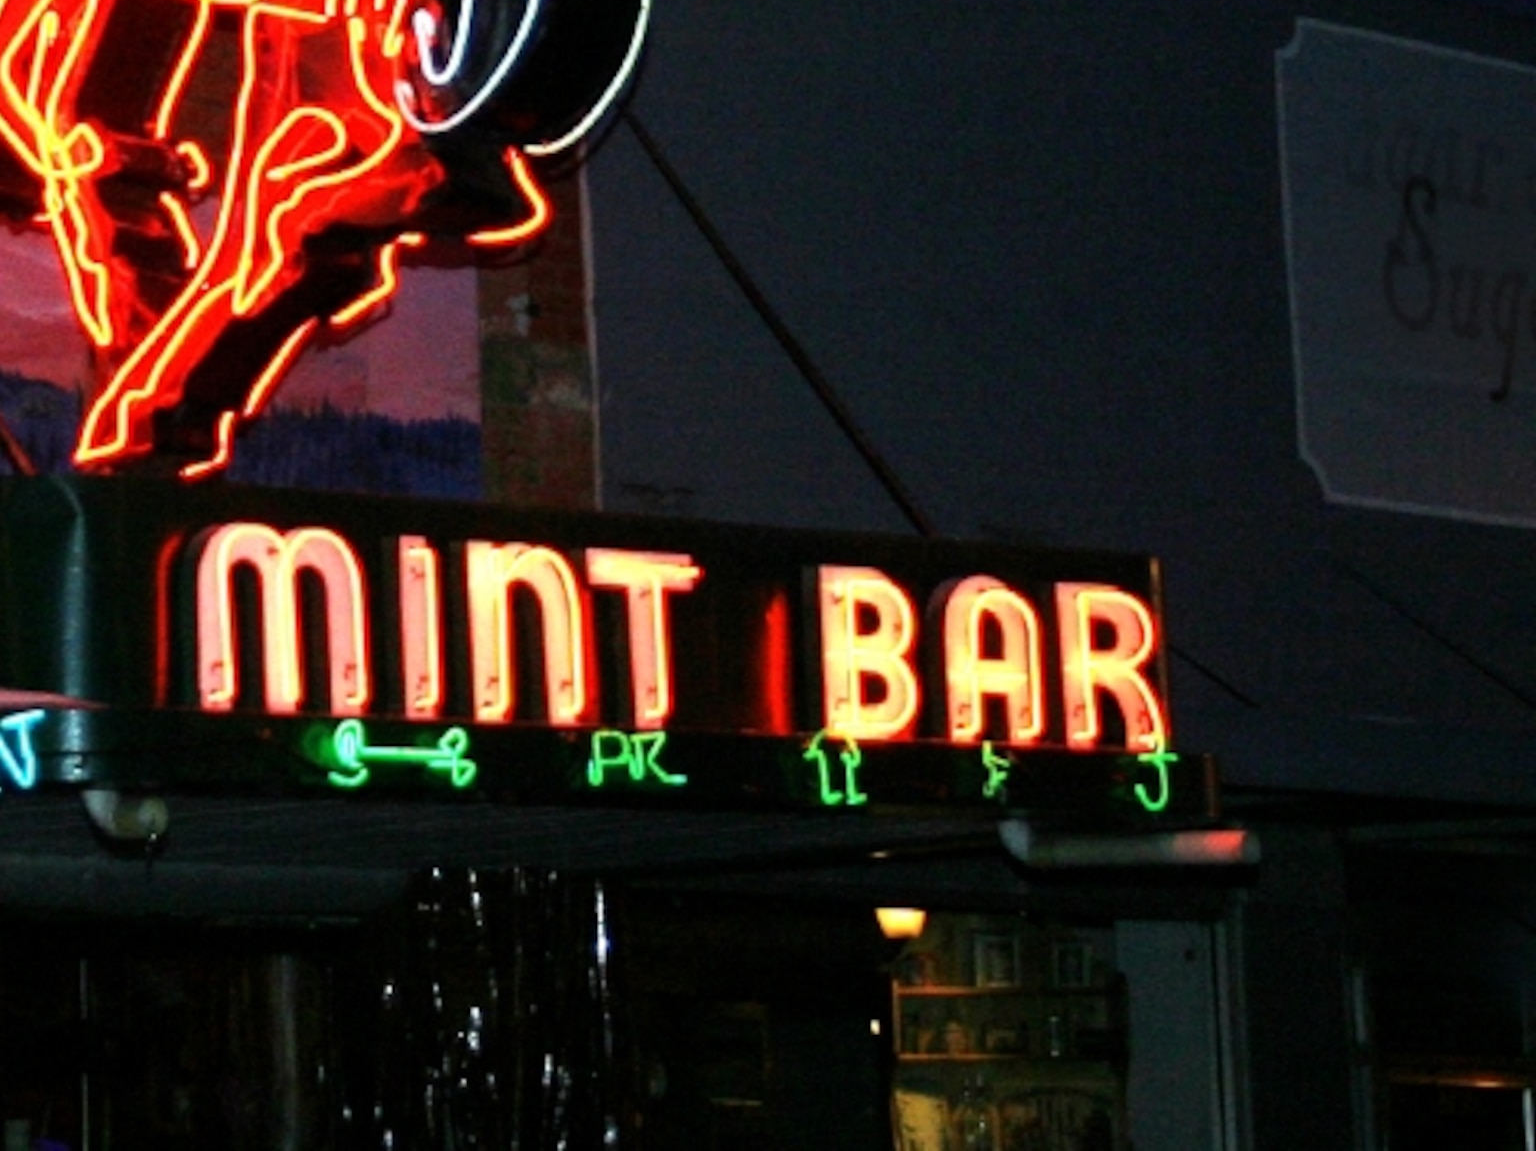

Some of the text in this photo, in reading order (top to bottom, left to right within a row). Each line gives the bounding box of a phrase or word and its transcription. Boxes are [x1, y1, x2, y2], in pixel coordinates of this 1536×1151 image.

[1382, 174, 1536, 405] Sug
[196, 522, 1166, 751] MINT BAR
